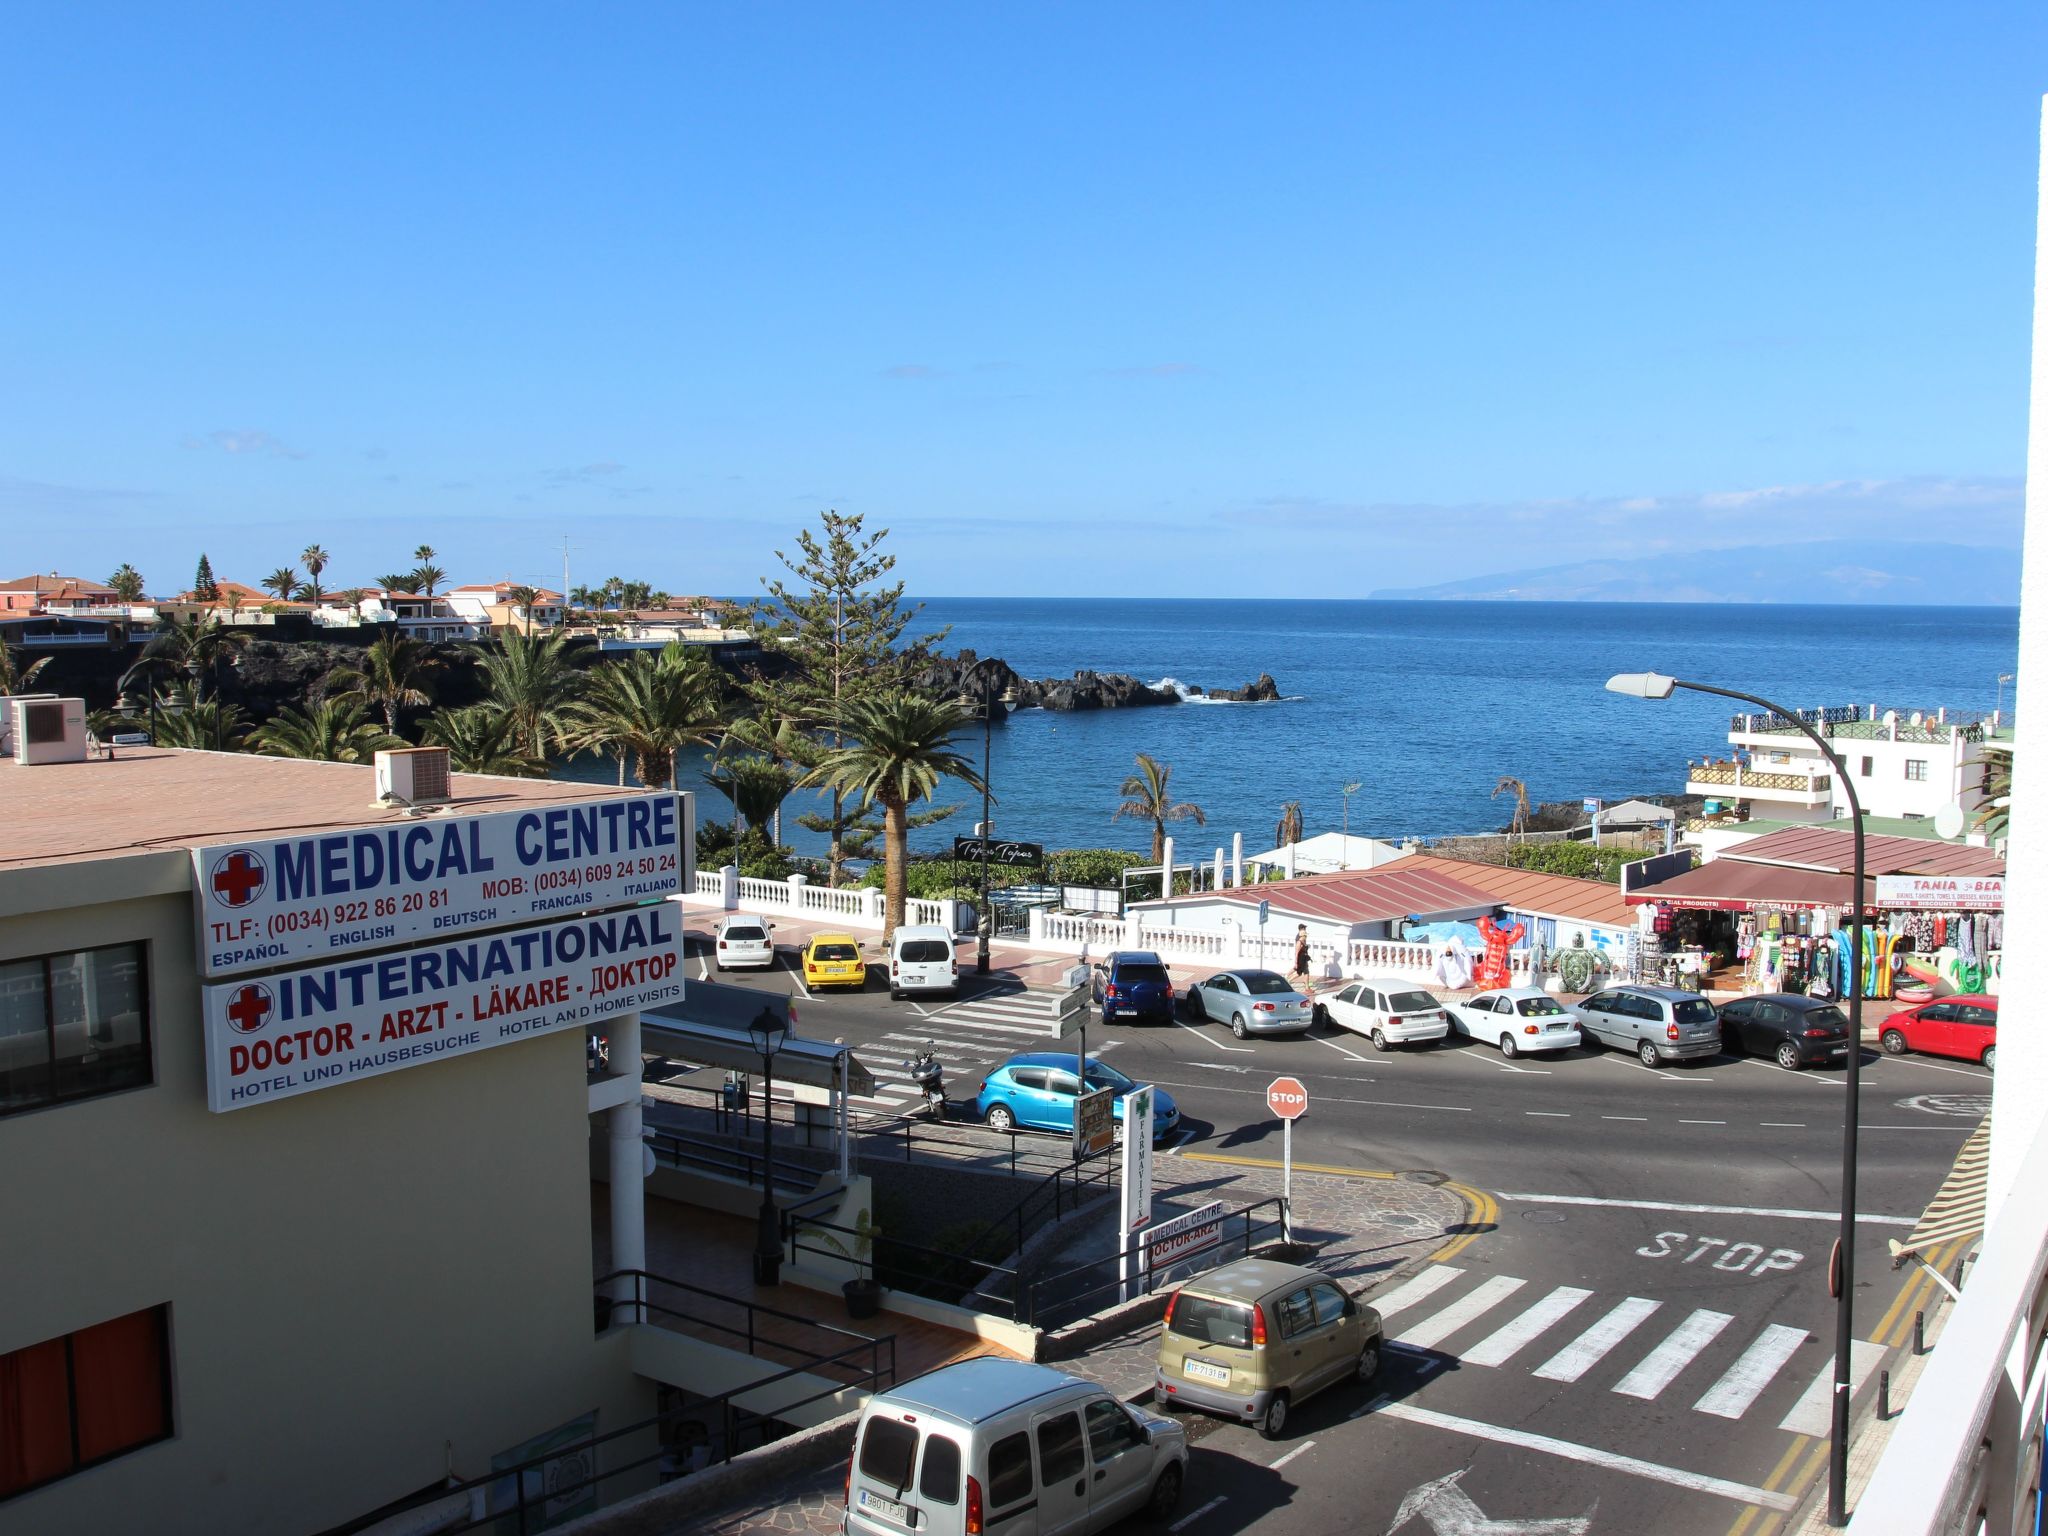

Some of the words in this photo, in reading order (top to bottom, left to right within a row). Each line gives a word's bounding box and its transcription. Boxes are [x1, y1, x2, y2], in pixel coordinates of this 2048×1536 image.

[275, 821, 494, 902] MEDICAL
[515, 796, 676, 866] CENTRE
[1913, 881, 1956, 891] TANIA
[211, 918, 260, 943] TLF:
[268, 907, 330, 939] (0034)
[334, 901, 369, 924] 922
[374, 897, 396, 917] 86
[402, 892, 423, 913] 20
[429, 888, 448, 908] 81
[482, 877, 528, 899] MOB:
[534, 867, 582, 895] (0034)
[585, 863, 612, 883] 609
[617, 860, 634, 878] 24
[638, 857, 655, 874] 50
[659, 853, 676, 871] 24
[212, 943, 289, 967] ESPAÑOL
[329, 925, 395, 947] ENGLISH
[433, 907, 497, 929] DEUTSCH
[531, 891, 592, 912] FRANCAIS
[624, 877, 677, 896] ITALIANO
[279, 911, 672, 1021] INTERNATIONAL
[229, 1022, 355, 1077] DOCTOR
[379, 1001, 449, 1042] ARZT
[473, 975, 570, 1021] LÄKARE
[589, 952, 677, 1000] ДОКТОР
[231, 1073, 297, 1100] HOTEL
[303, 1063, 343, 1083] UND
[350, 1031, 480, 1072] HAUSBESUCHE
[500, 1016, 551, 1037] HOTEL
[594, 994, 635, 1014] HOME
[637, 985, 680, 1004] VISITS
[1271, 1092, 1304, 1105] STOP
[1153, 1219, 1188, 1241] MEDICAL
[1191, 1203, 1222, 1224] CENTRE
[1635, 1231, 1805, 1276] STOP
[867, 1494, 886, 1511] 9801
